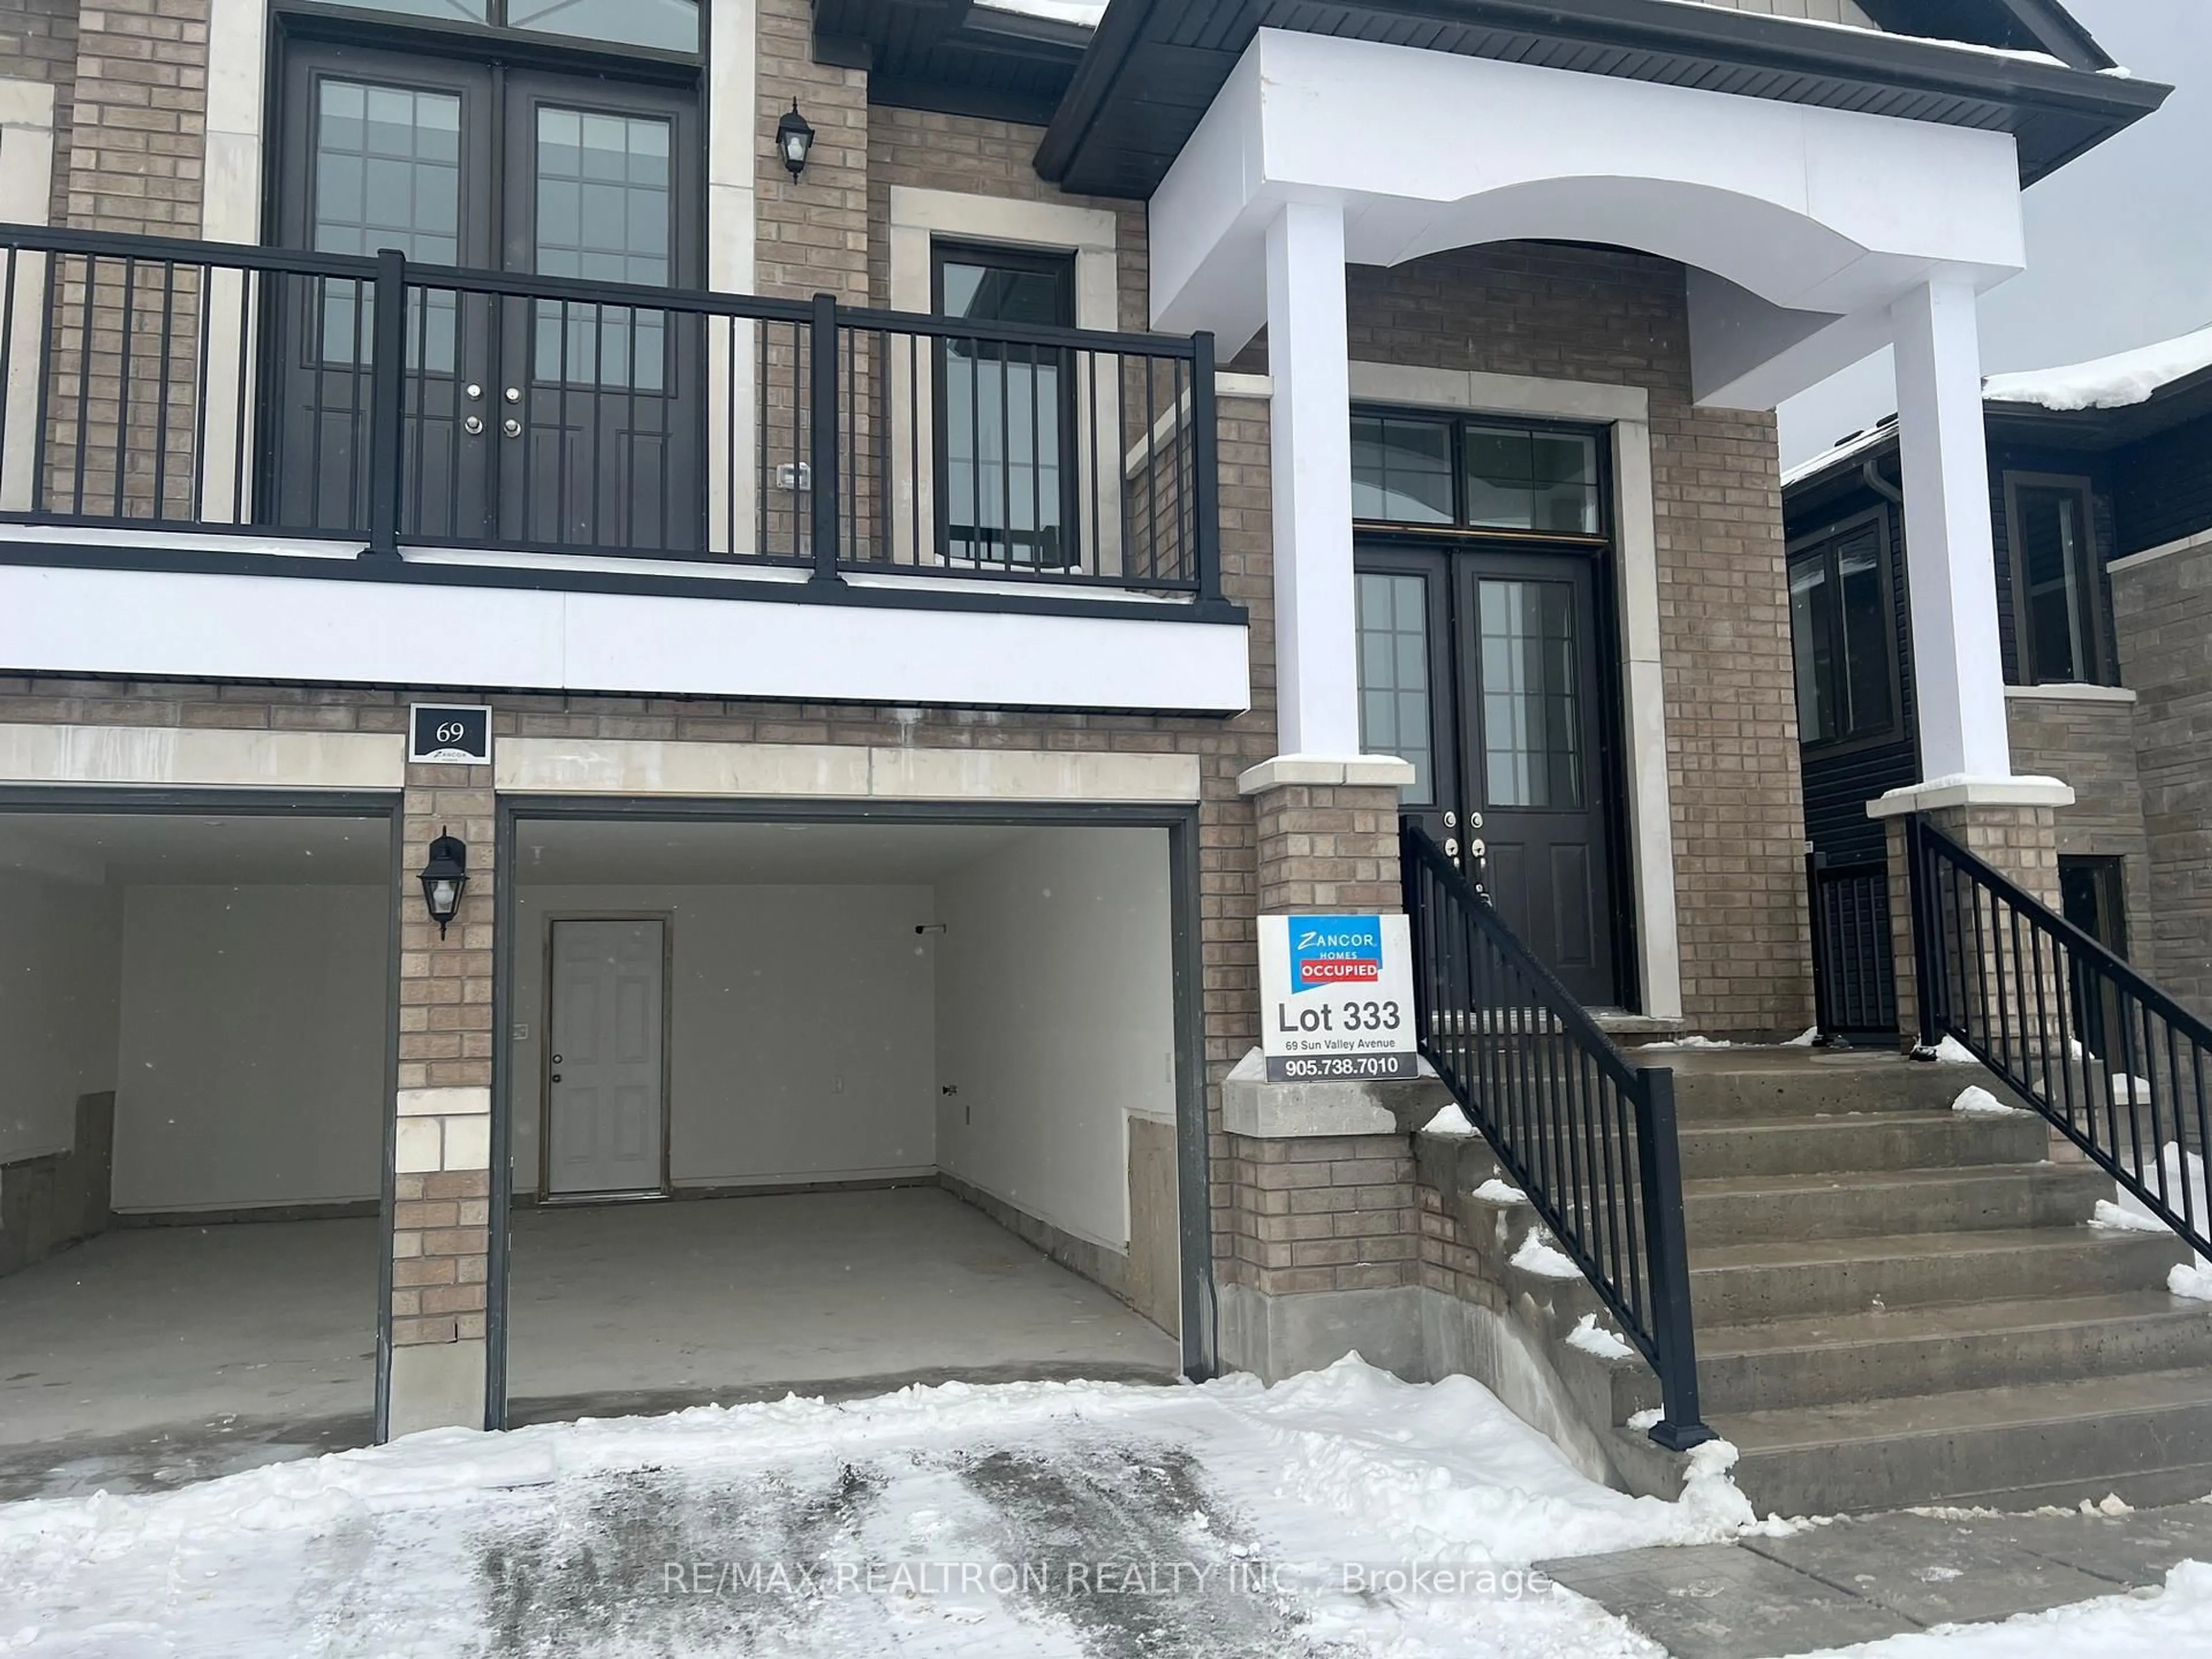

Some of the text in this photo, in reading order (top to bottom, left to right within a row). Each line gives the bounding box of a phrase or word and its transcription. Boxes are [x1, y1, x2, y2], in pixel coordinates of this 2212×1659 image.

[437, 722, 464, 743] 69
[1298, 931, 1374, 950] ZANCOR
[1320, 952, 1358, 960] HOMES
[1302, 965, 1377, 976] OCCUPIED
[1278, 1001, 1401, 1032] Lot 333
[1286, 1039, 1396, 1051] 69 Sun Valley Avenue
[1285, 1057, 1399, 1077] 905.738.7010
